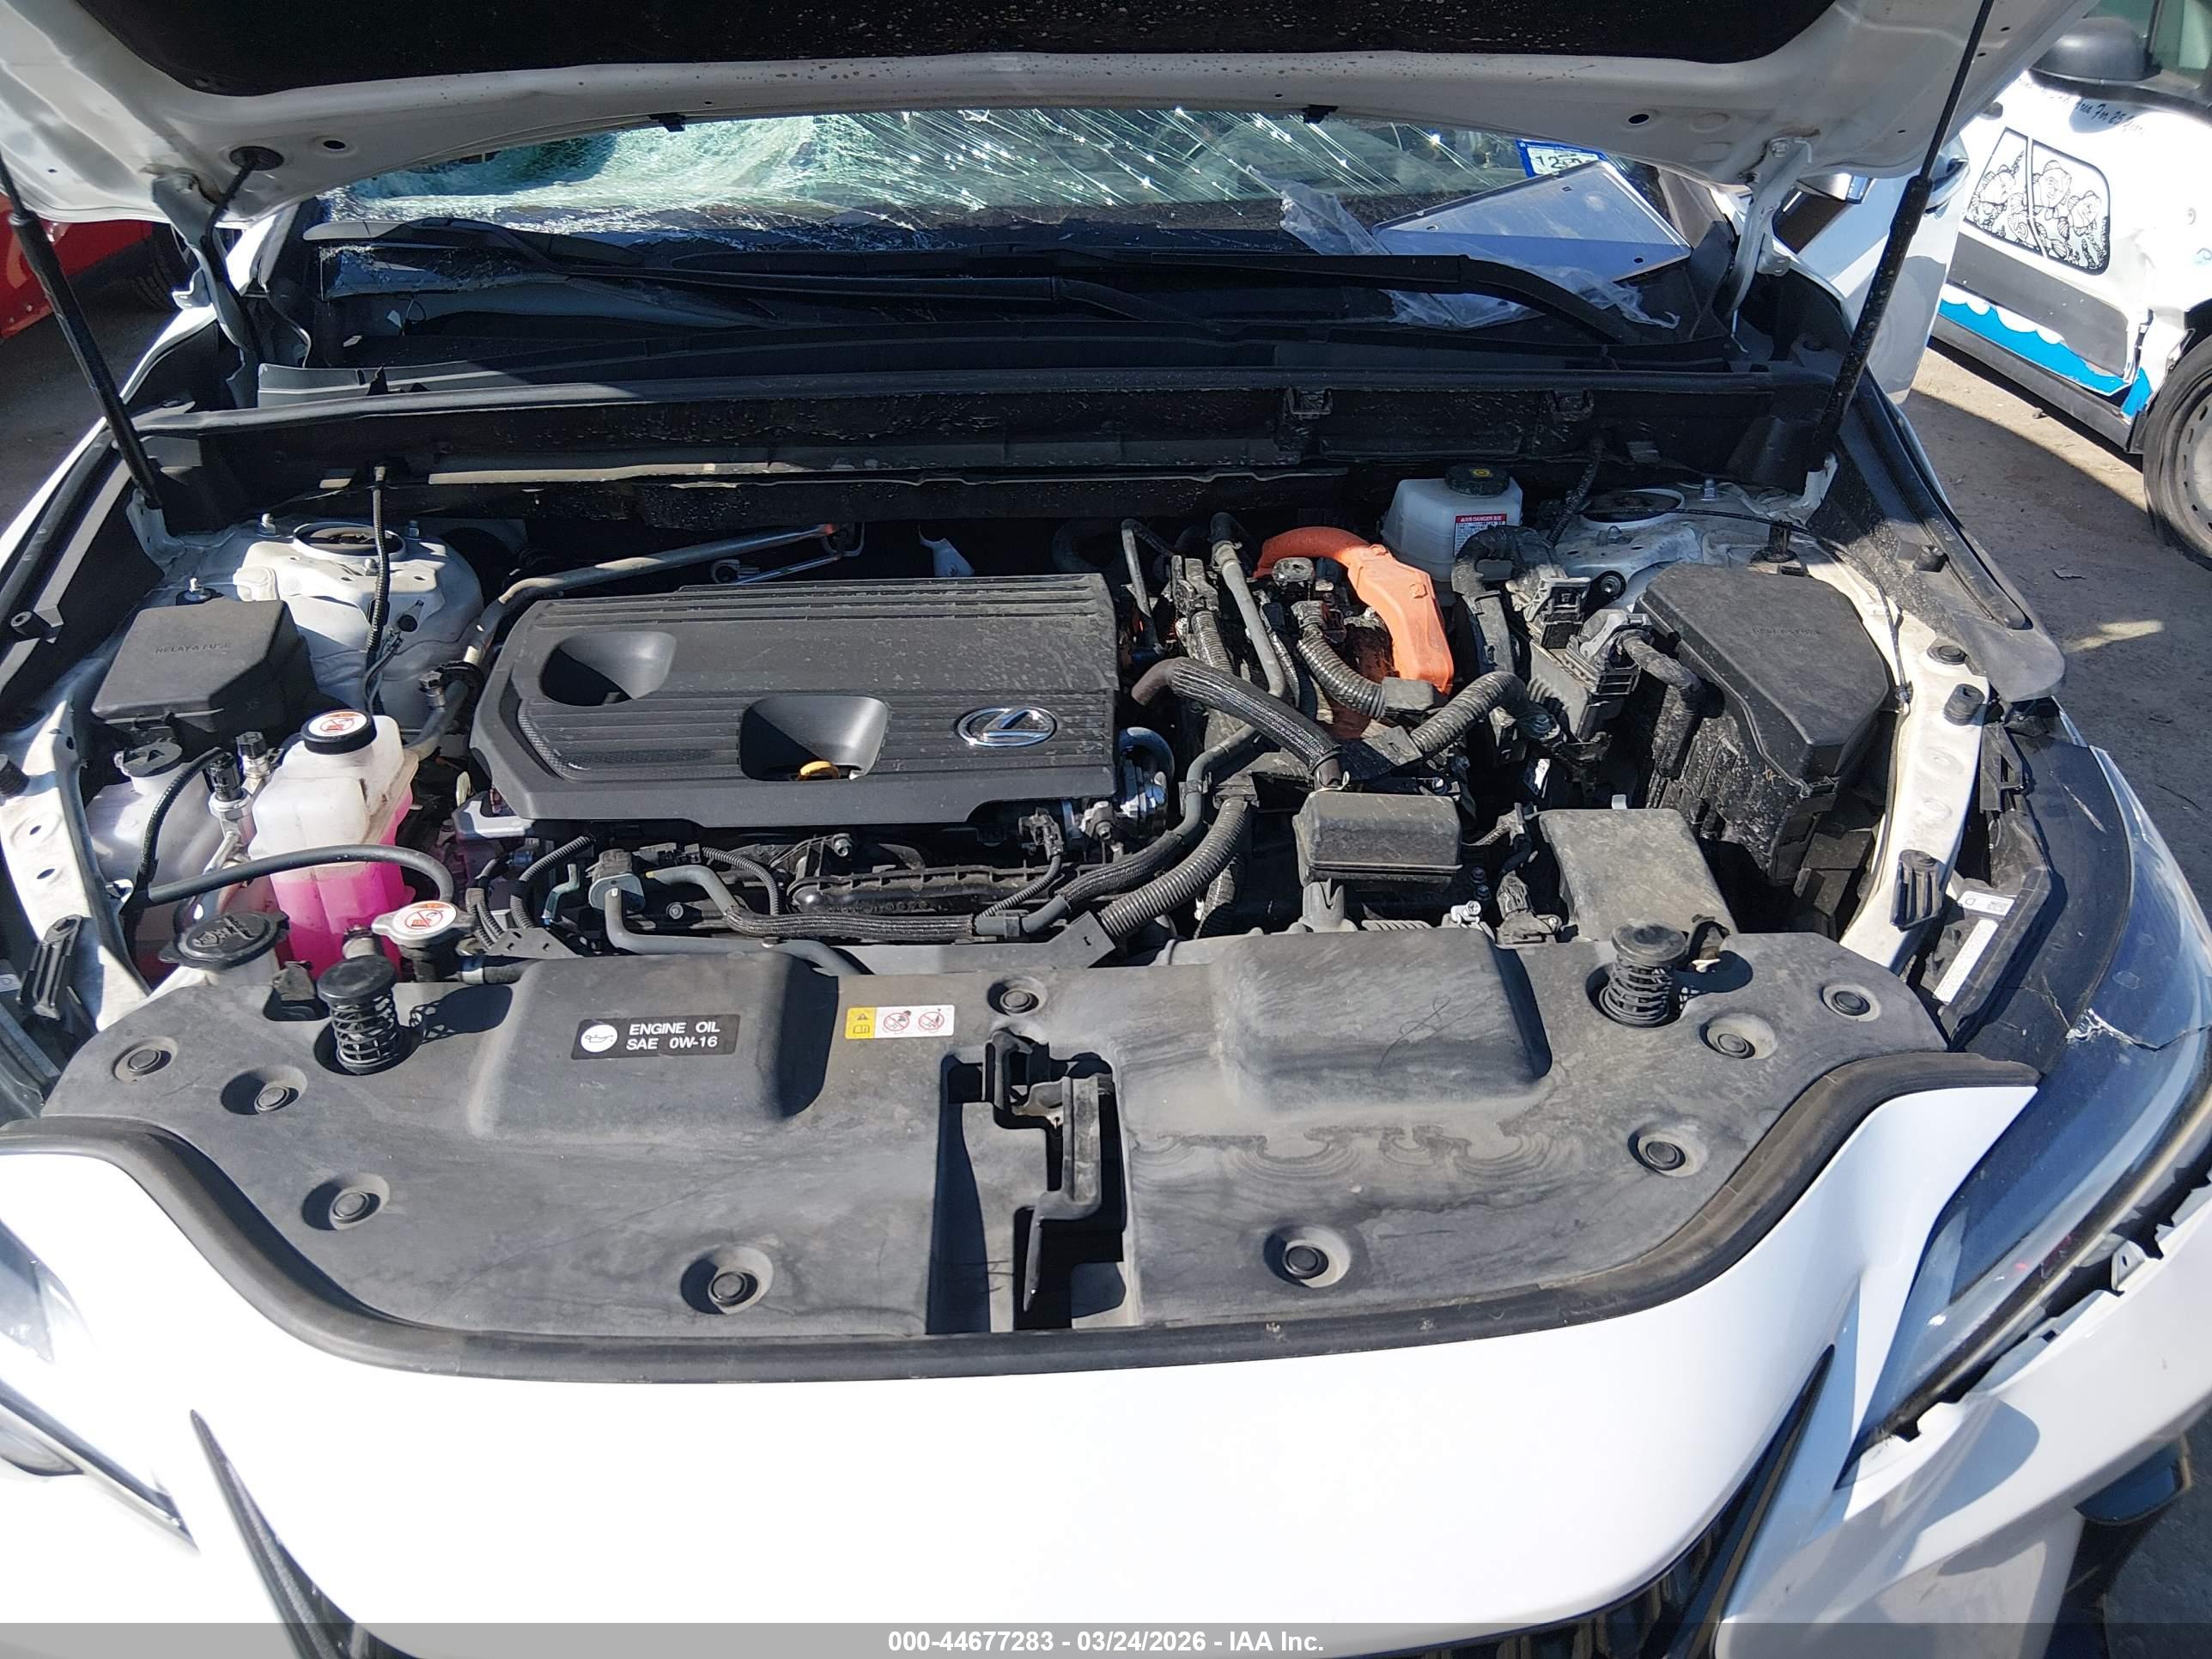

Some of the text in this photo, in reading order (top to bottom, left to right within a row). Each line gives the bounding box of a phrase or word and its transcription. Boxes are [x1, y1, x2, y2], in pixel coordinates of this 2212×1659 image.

[629, 1021, 721, 1036] ENGINE OIL
[625, 1036, 719, 1051] SAE 0W-16
